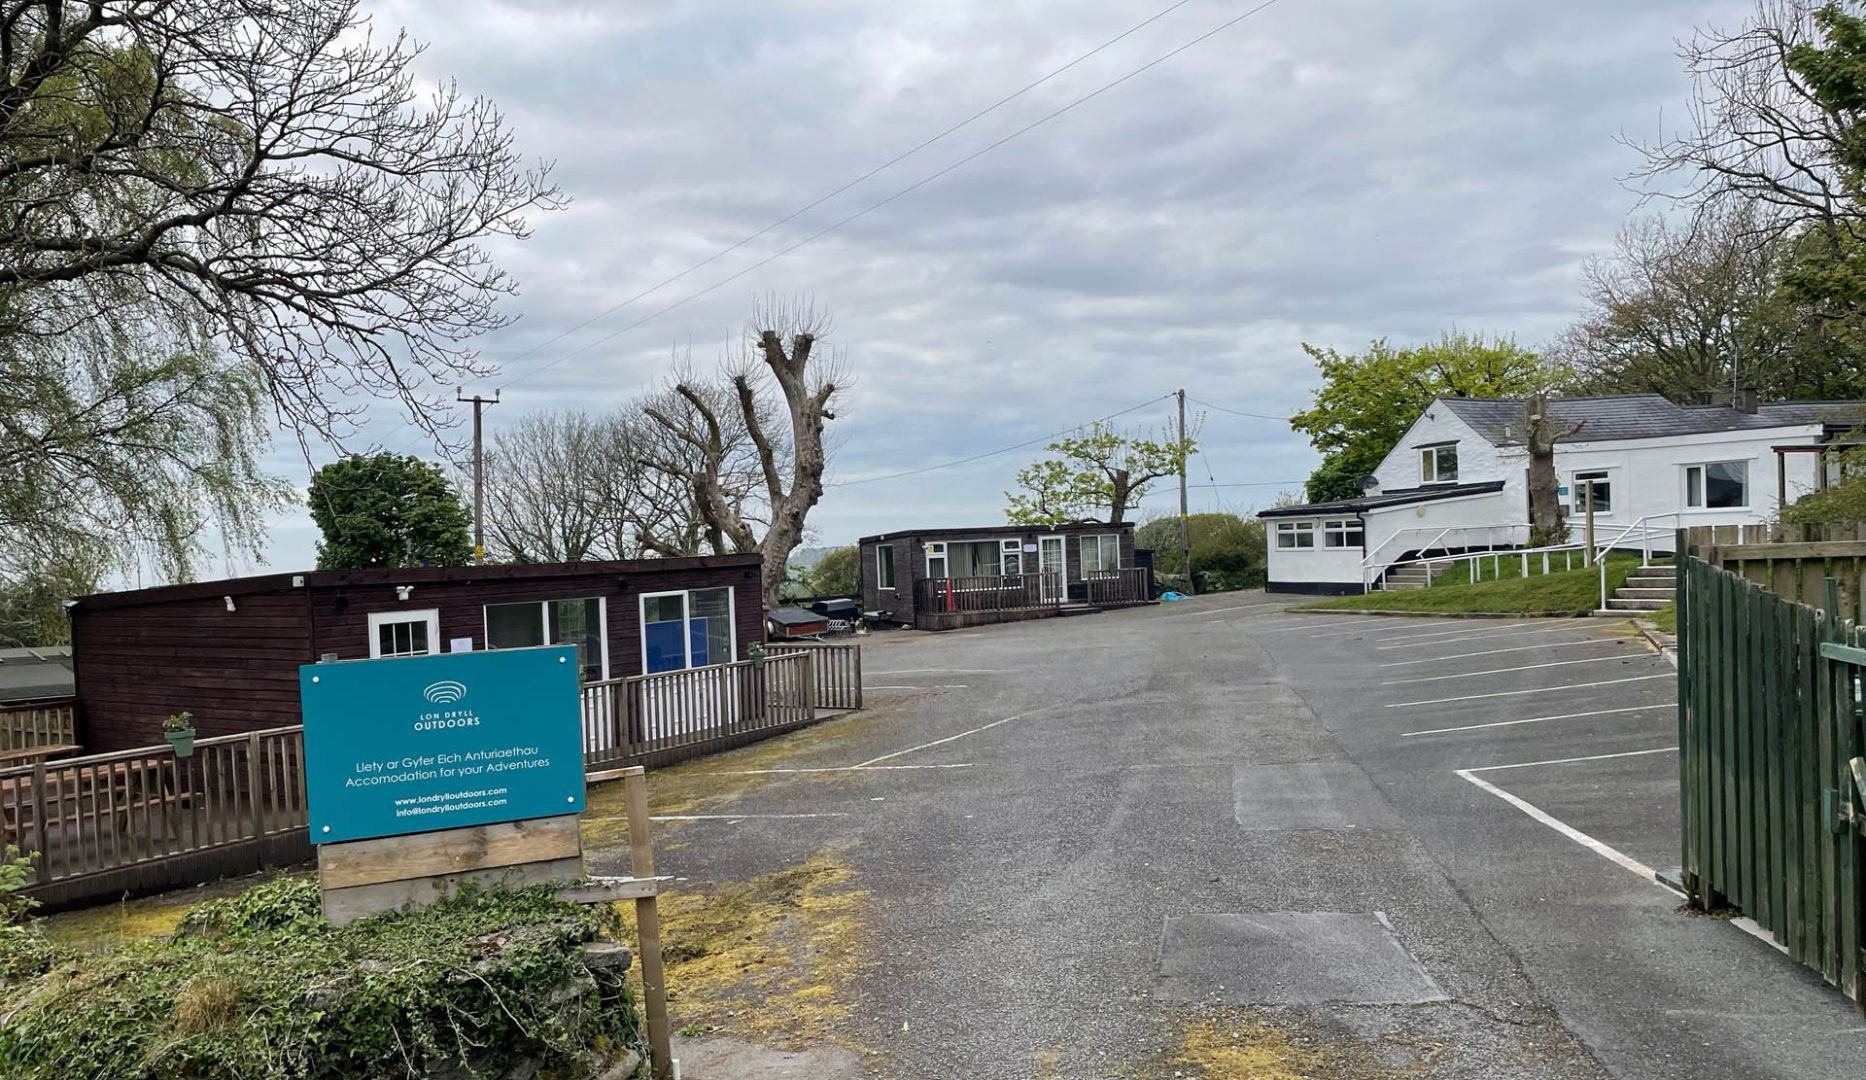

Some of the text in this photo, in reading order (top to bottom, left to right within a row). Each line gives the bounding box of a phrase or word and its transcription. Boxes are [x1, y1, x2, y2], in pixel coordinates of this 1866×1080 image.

[414, 716, 480, 731] OUTDOORS
[420, 710, 473, 721] LON DRYLL
[386, 760, 400, 770] ar
[402, 756, 436, 769] Gyfer
[437, 753, 462, 765] Eich
[464, 746, 539, 762] Anturiaethau
[345, 758, 550, 788] Accomodation for your Adventures
[394, 787, 508, 806] www.londrylloutdoors.com
[396, 798, 508, 817] info@londrylloutdoors.com
